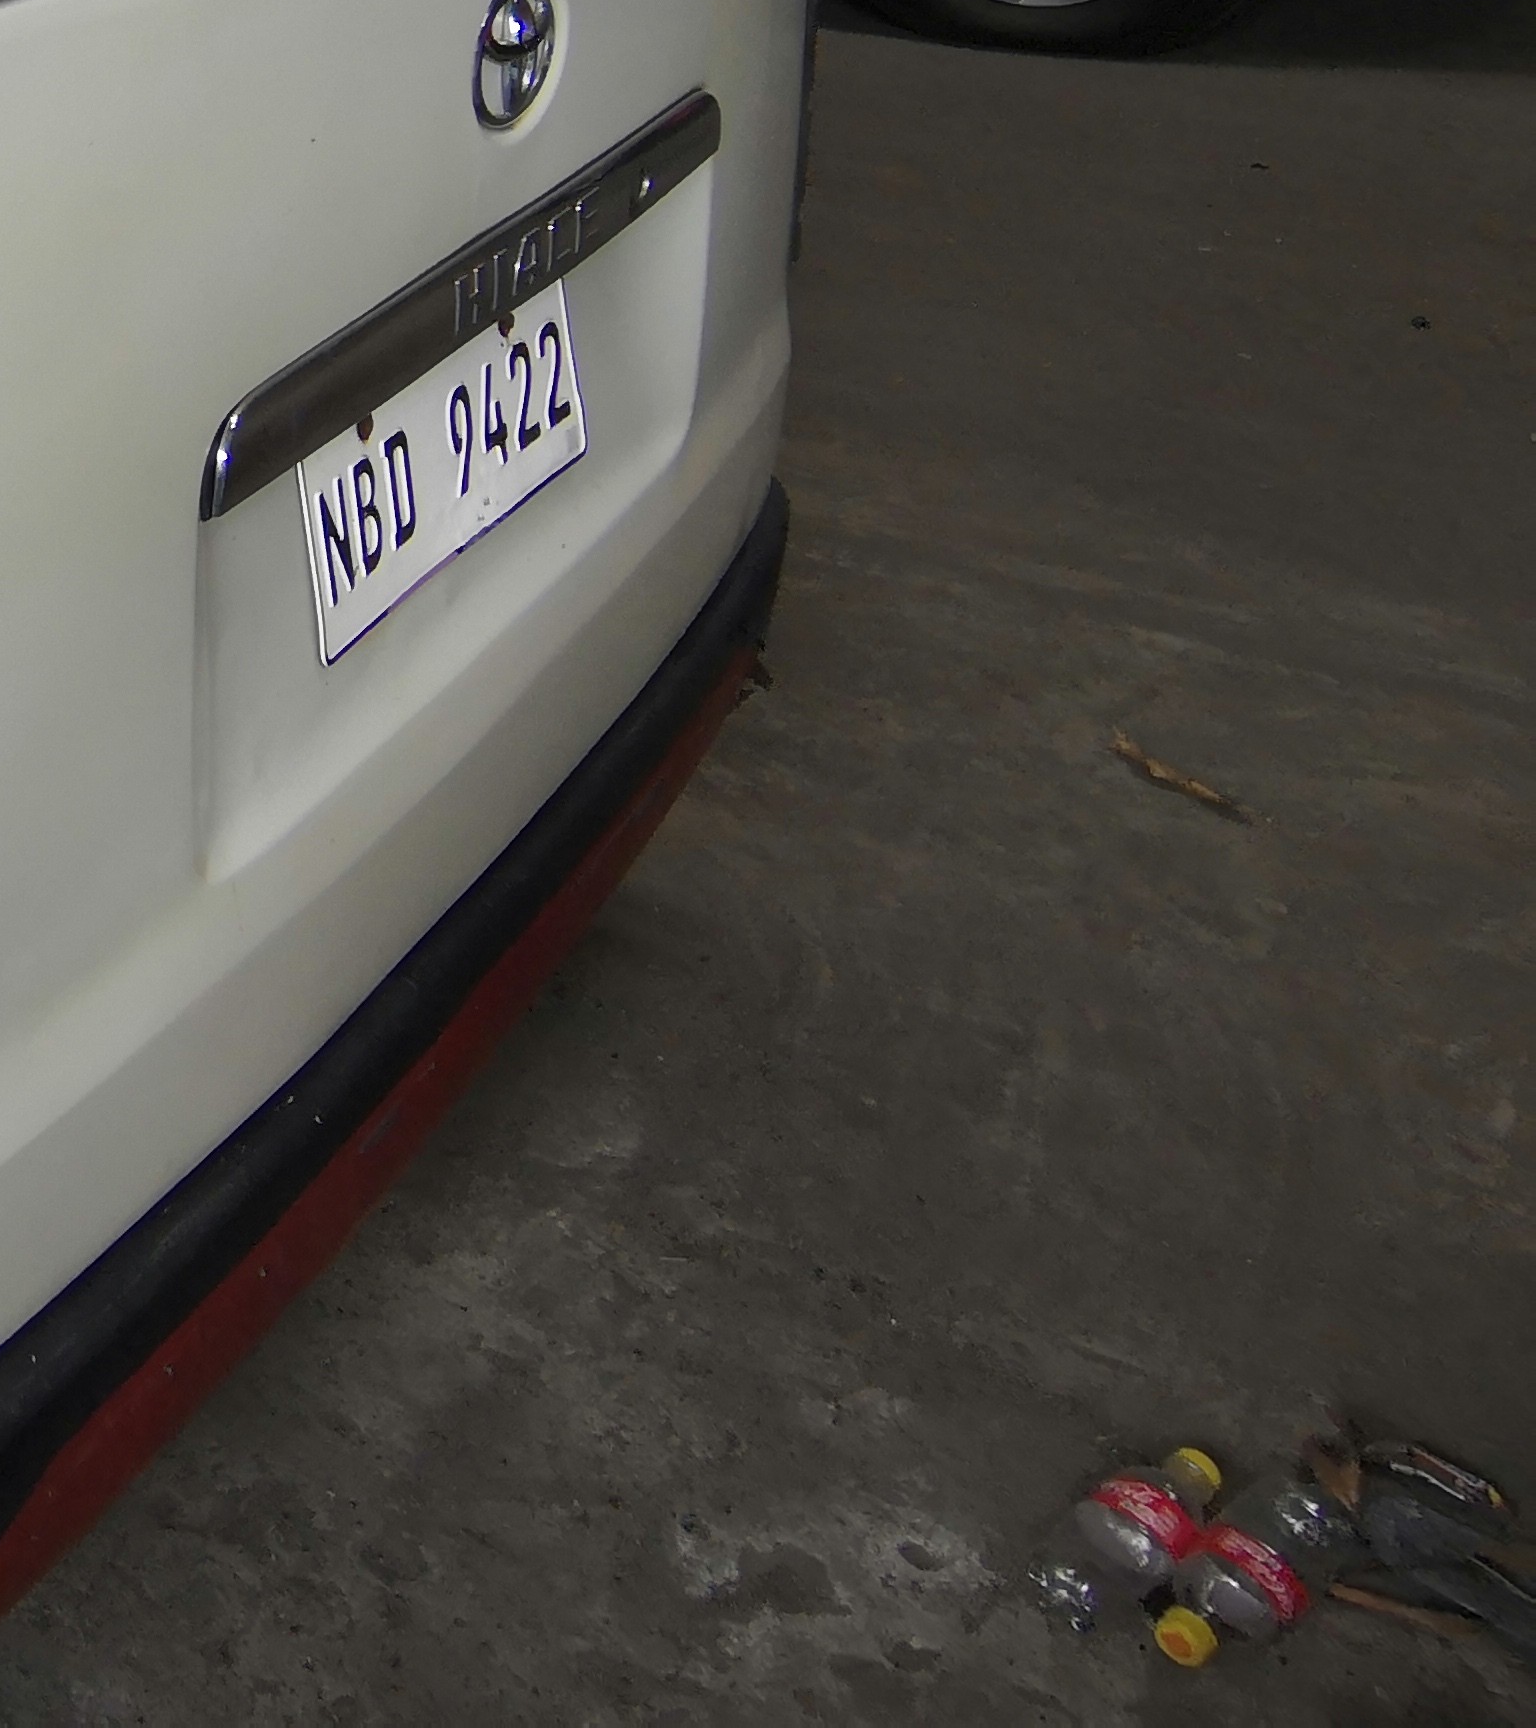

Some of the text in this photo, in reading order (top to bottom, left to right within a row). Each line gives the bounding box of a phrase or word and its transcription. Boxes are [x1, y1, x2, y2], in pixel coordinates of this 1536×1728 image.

[453, 186, 600, 337] HIACE
[313, 320, 571, 608] NBD 9422
